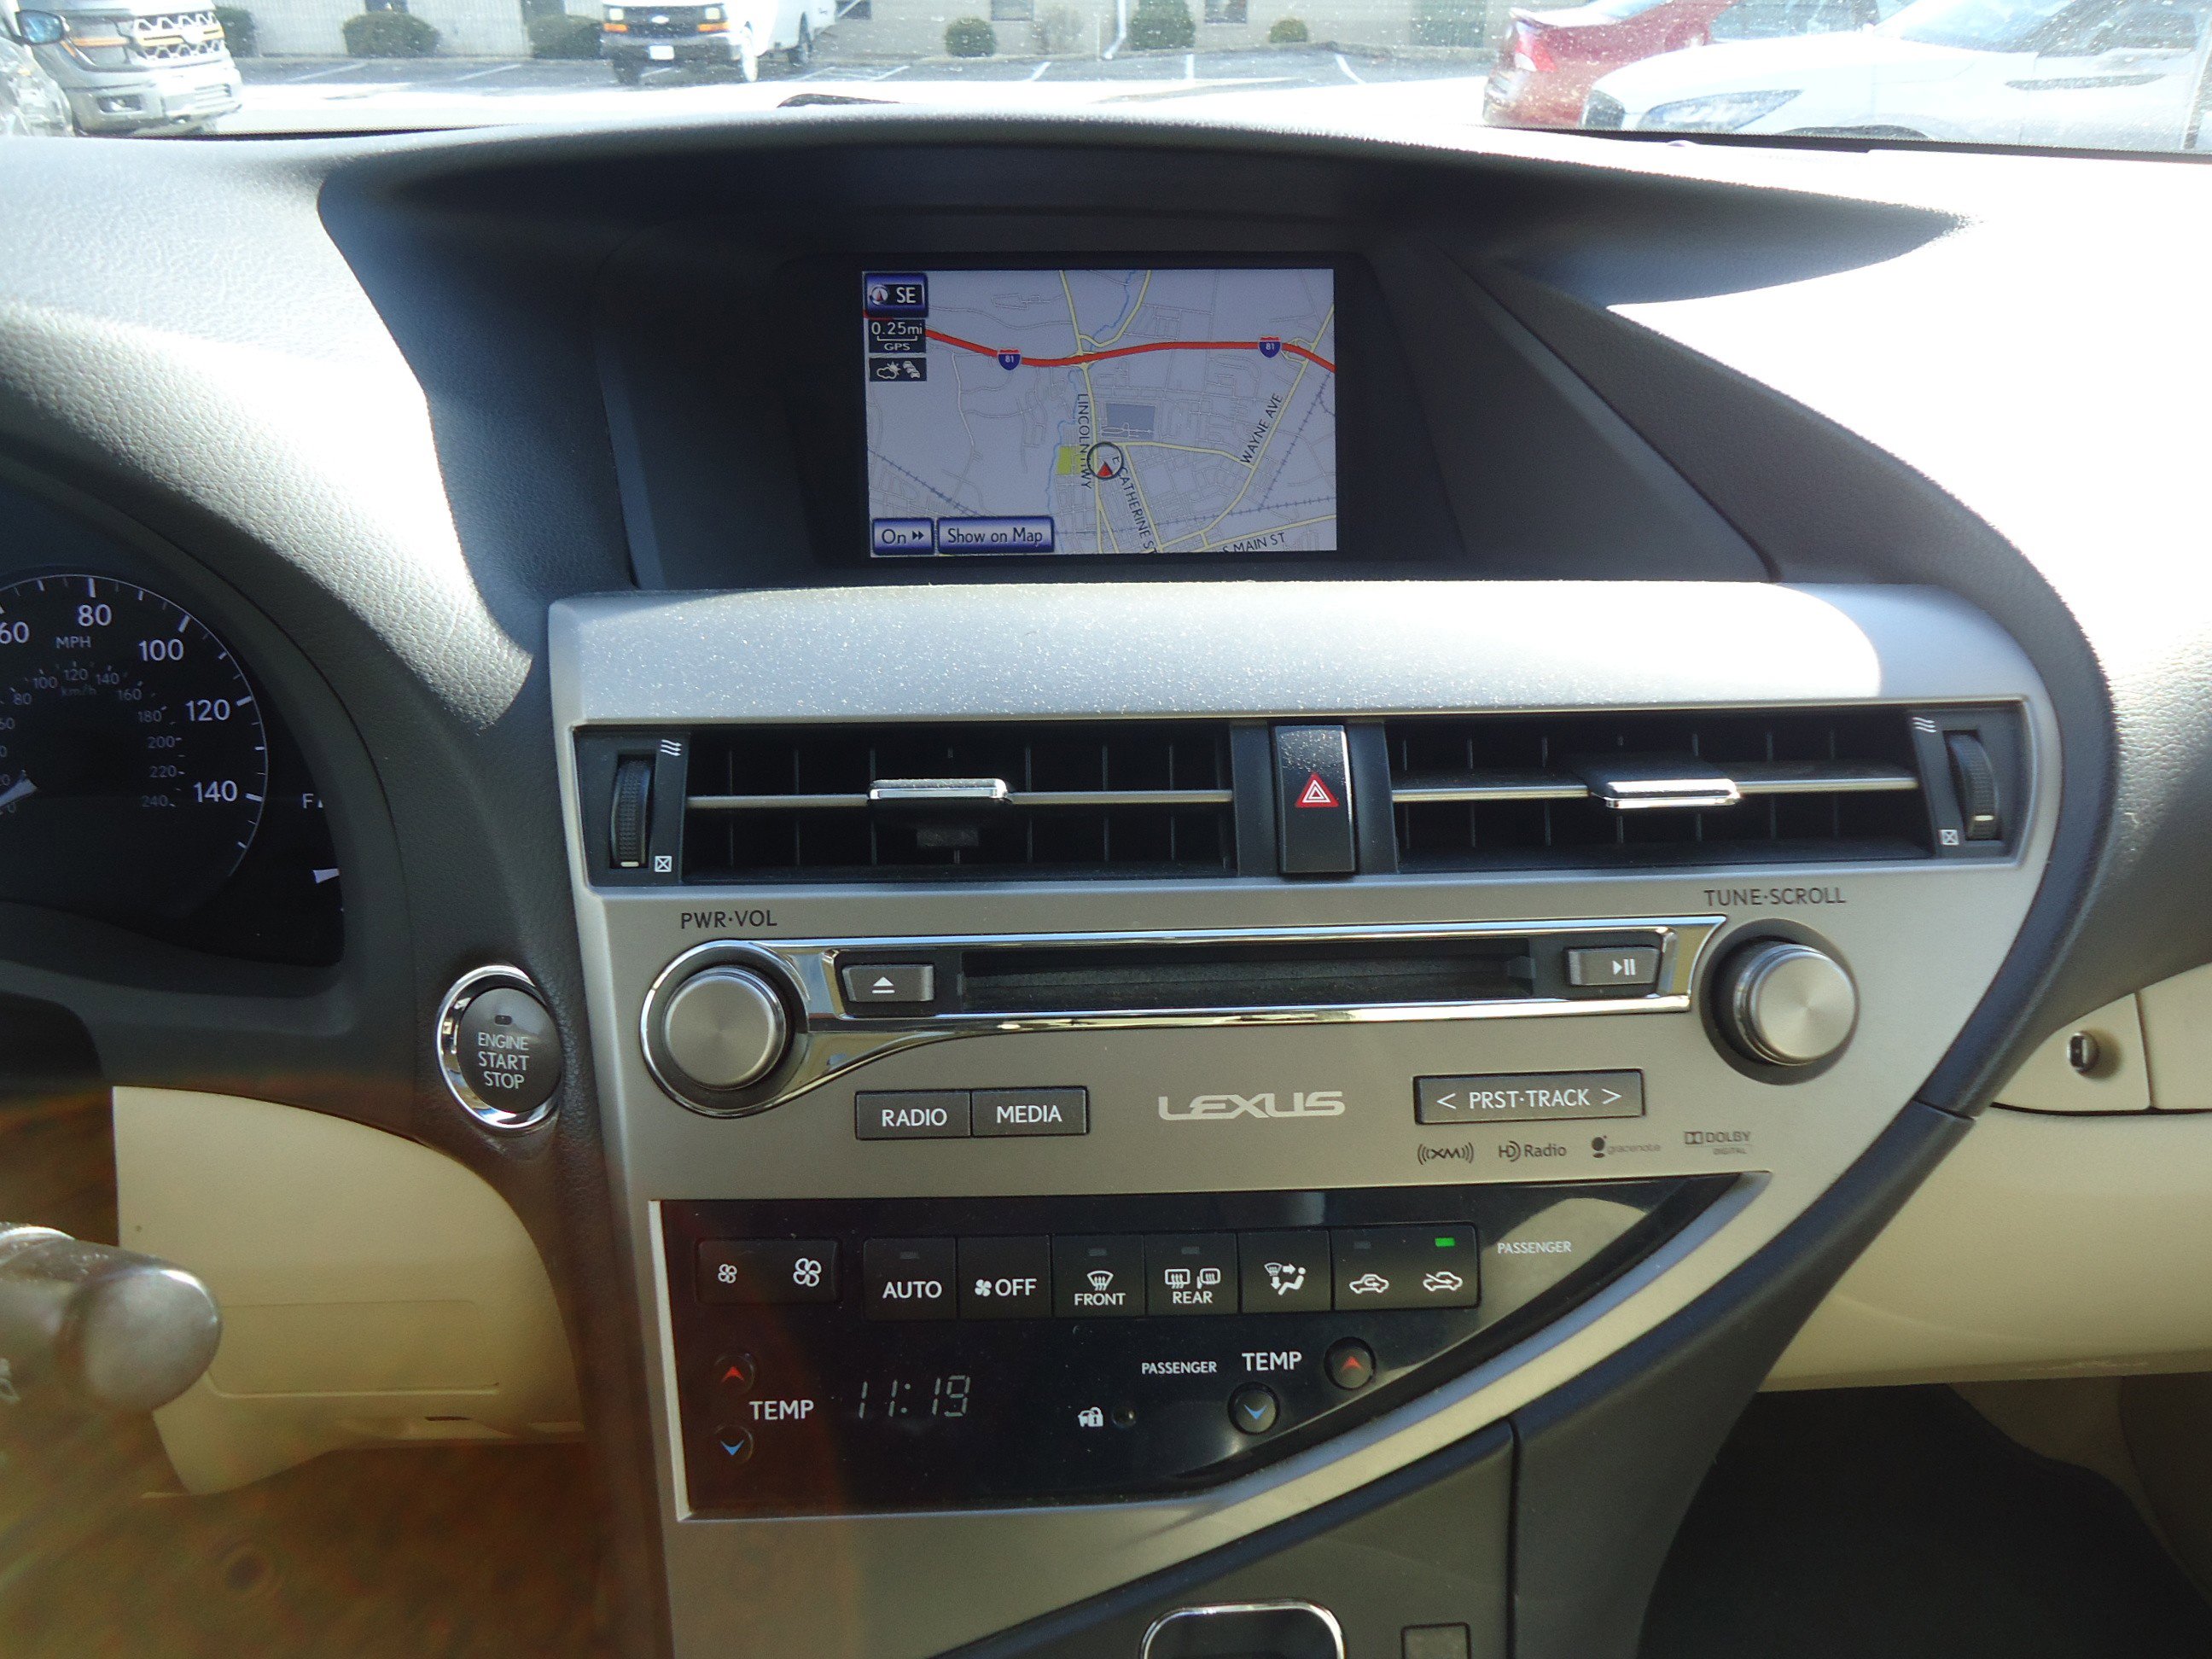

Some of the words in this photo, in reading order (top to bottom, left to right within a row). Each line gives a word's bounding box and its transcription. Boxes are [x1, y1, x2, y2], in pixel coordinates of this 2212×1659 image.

[896, 287, 917, 304] SE
[871, 322, 923, 335] 0.25mi
[884, 342, 911, 352] GPS
[1266, 342, 1275, 351] 81
[1077, 393, 1091, 453] LINCOLN
[1240, 419, 1270, 463] WAYNE
[1266, 393, 1283, 418] AVE
[1117, 467, 1151, 538] CATHERINE
[882, 528, 906, 544] On
[947, 528, 985, 544] Show
[990, 531, 1008, 543] on
[1013, 527, 1043, 546] Map
[1233, 537, 1267, 552] MAIN
[1270, 532, 1284, 545] ST
[78, 603, 113, 627] 80
[0, 621, 30, 644] 60
[55, 636, 91, 649] MPH
[138, 638, 184, 662] 100
[63, 668, 89, 681] 120
[96, 672, 120, 685] 140
[32, 677, 58, 690] 100
[13, 692, 32, 706] 80
[118, 688, 143, 701] 160
[137, 710, 162, 724] 180
[185, 698, 230, 722] 120
[148, 736, 176, 749] 200
[149, 765, 178, 778] 220
[194, 780, 237, 804] 140
[142, 795, 170, 808] 240
[302, 793, 314, 809] F
[478, 1033, 529, 1051] ENGINE
[478, 1051, 529, 1070] START
[484, 1071, 525, 1089] STOP
[996, 1105, 1062, 1123] MEDIA
[1158, 1091, 1346, 1121] LEXUS
[882, 1109, 947, 1127] RADIO
[1705, 1131, 1751, 1143] DOLBY
[1524, 1143, 1568, 1158] Radio
[1497, 1240, 1572, 1254] PASSENGER
[882, 1281, 942, 1299] AUTO
[995, 1278, 1037, 1296] OFF
[1074, 1293, 1126, 1307] FRONT
[1173, 1290, 1213, 1305] REAR
[1142, 1361, 1218, 1375] PASSENGER
[1242, 1351, 1302, 1372] TEMP
[859, 1375, 971, 1418] 11:19
[749, 1400, 815, 1421] TEMP
